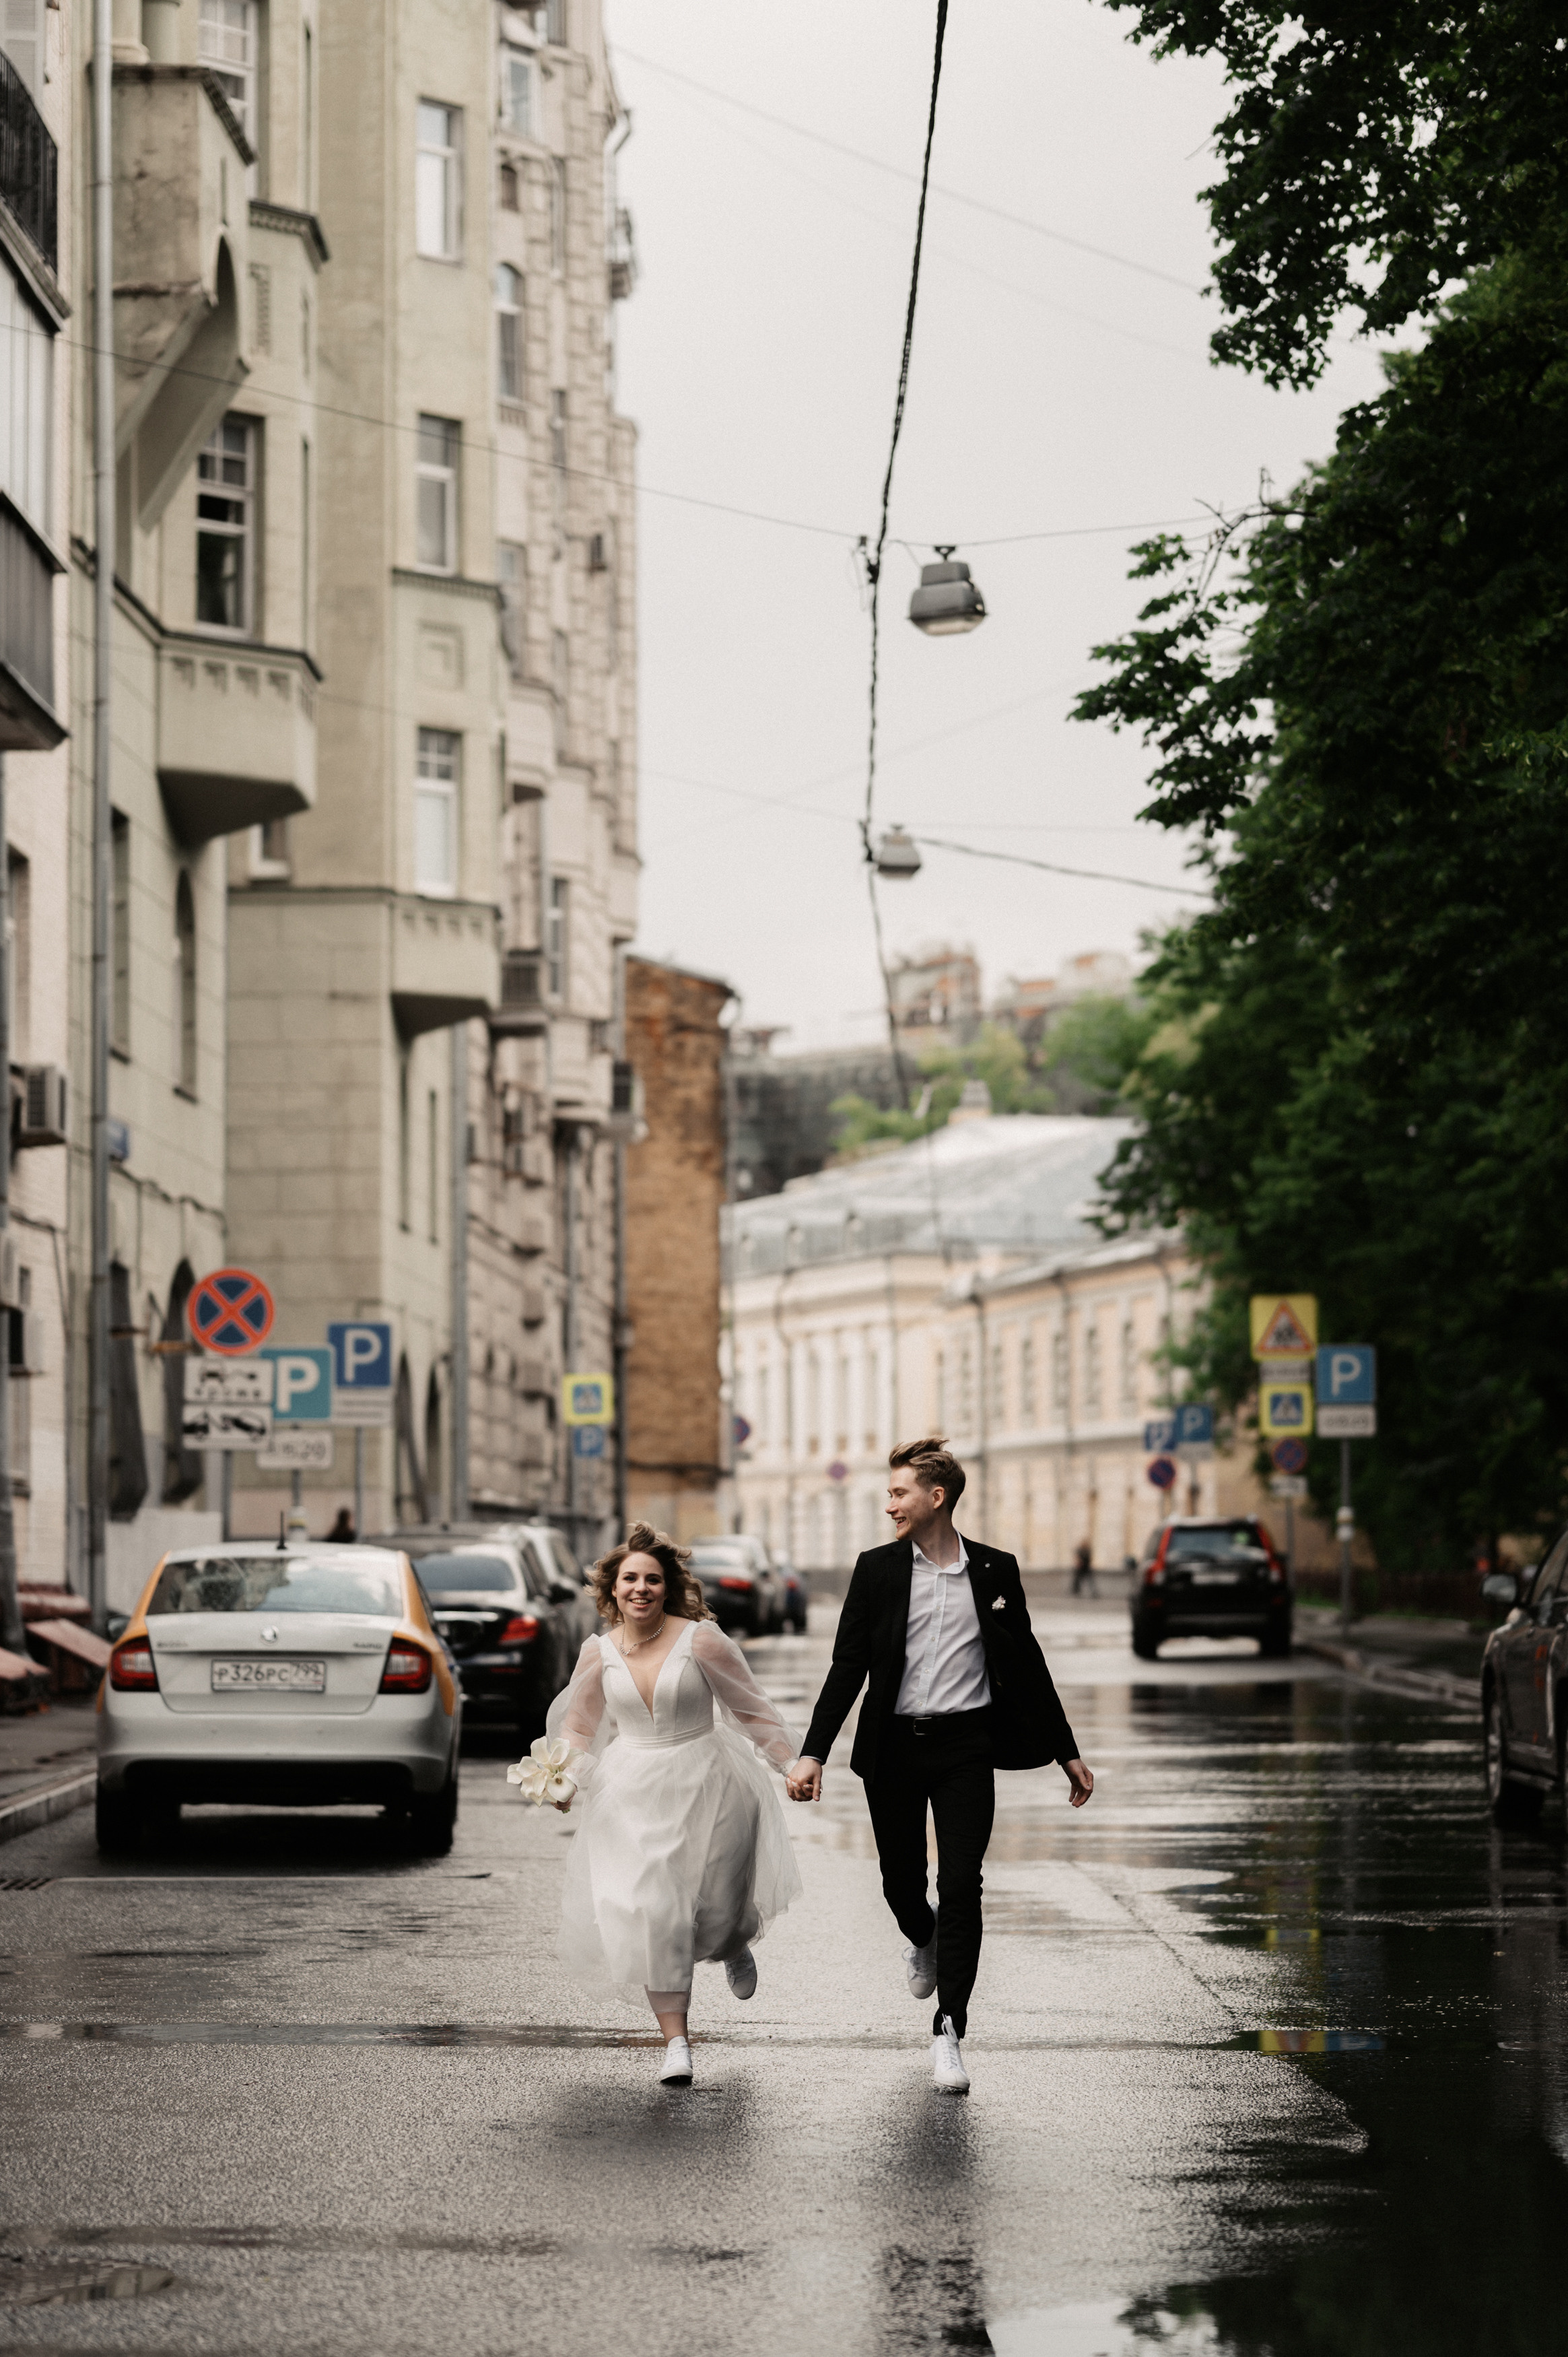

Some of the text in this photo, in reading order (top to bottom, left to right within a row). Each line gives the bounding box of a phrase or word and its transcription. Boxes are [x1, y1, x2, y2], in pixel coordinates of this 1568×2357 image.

[344, 1329, 382, 1382] P
[1331, 1353, 1361, 1397] P
[276, 1356, 320, 1413] P
[581, 1427, 600, 1452] P
[1183, 1406, 1204, 1439] P
